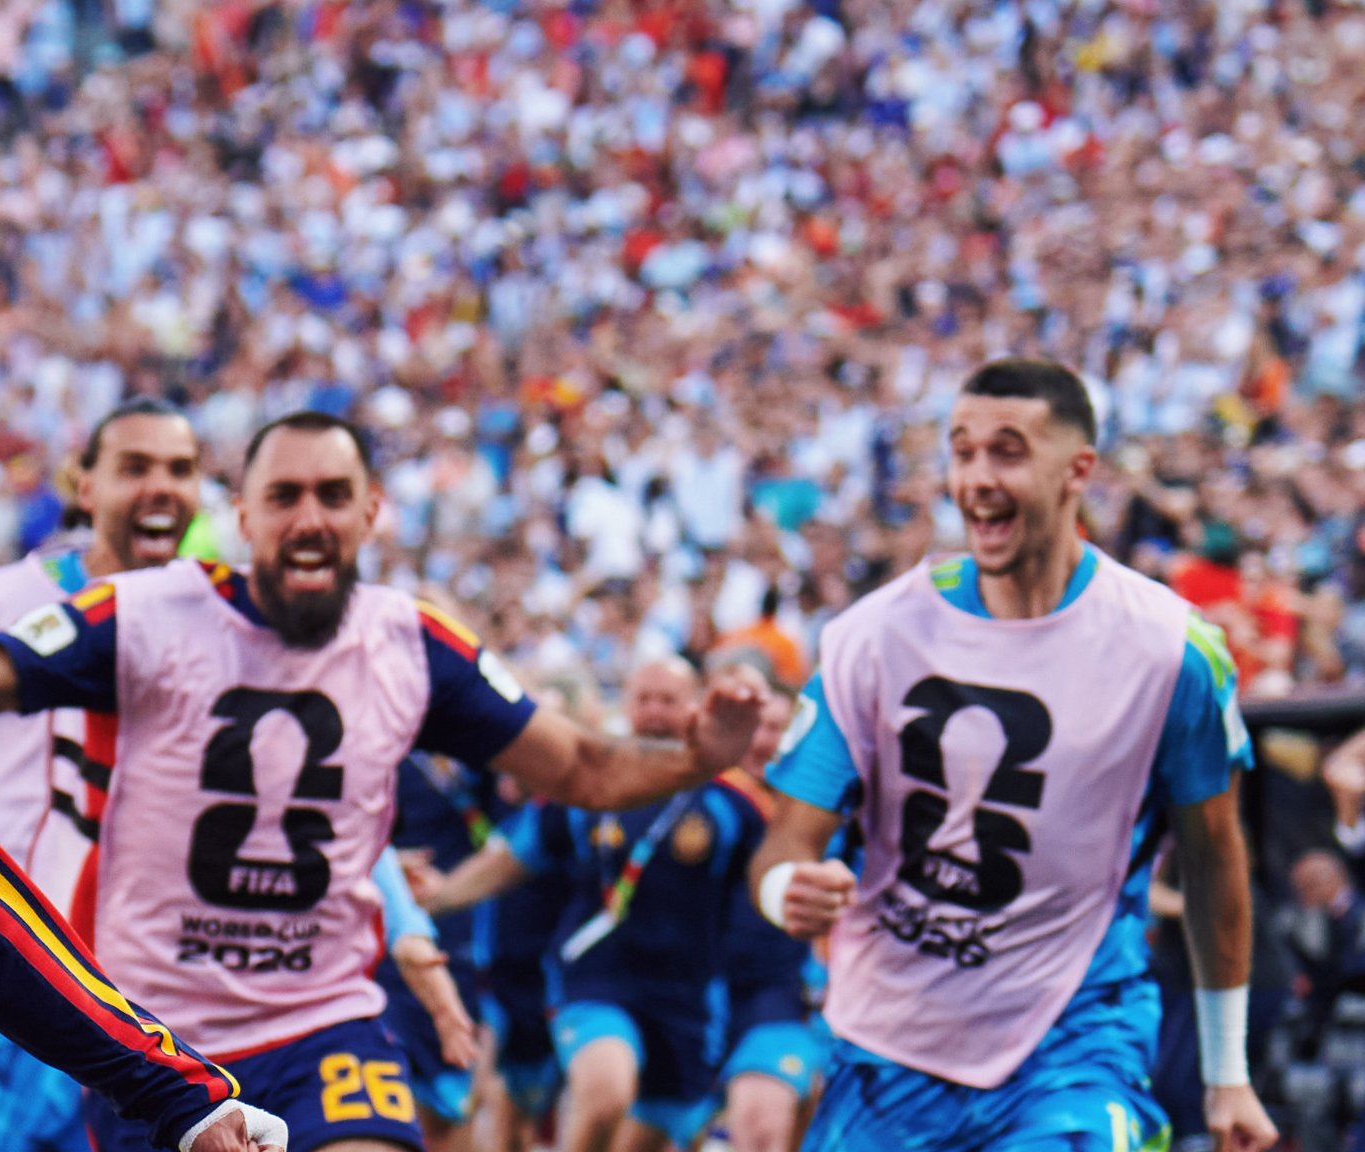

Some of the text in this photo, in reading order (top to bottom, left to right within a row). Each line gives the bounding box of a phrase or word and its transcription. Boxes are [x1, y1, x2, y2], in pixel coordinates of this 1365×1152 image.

[228, 864, 297, 896] FIFA
[180, 914, 274, 939] WORLD
[176, 937, 313, 973] 2026
[319, 1051, 416, 1124] 26
